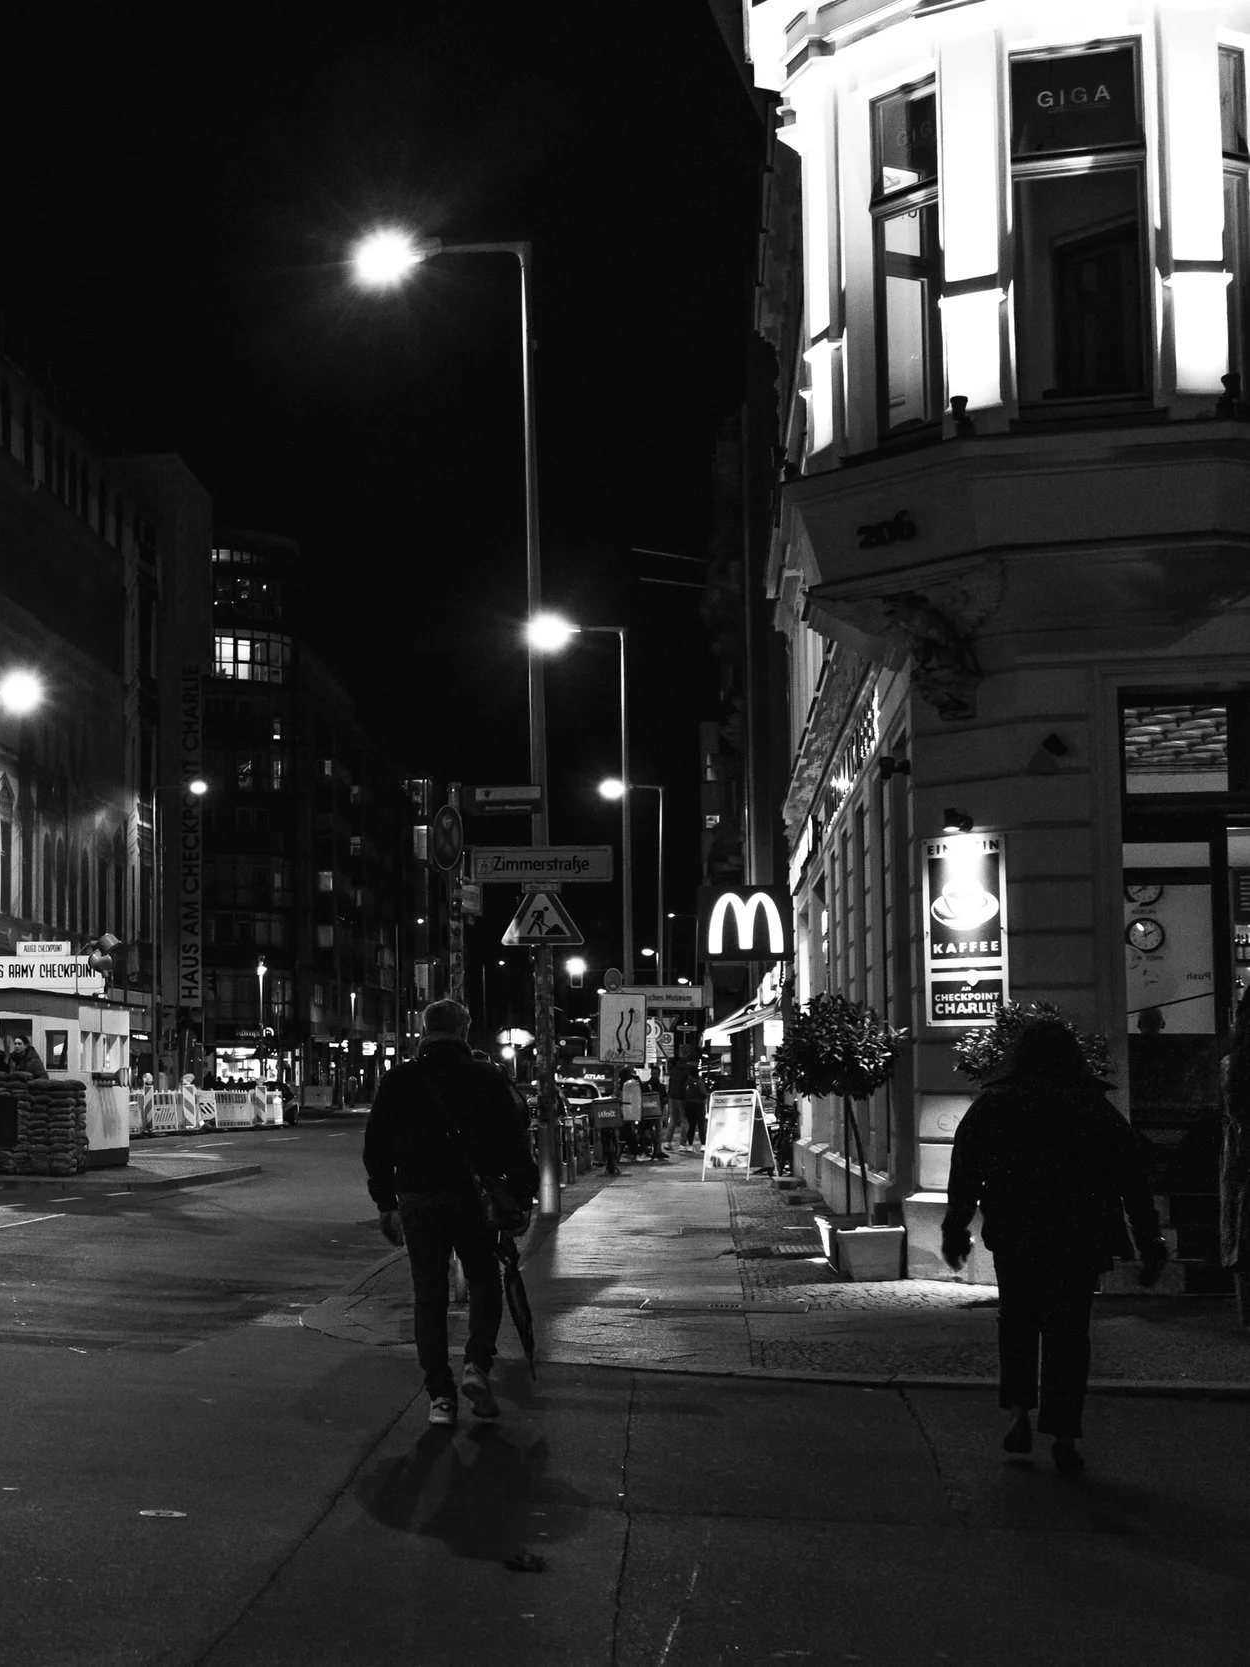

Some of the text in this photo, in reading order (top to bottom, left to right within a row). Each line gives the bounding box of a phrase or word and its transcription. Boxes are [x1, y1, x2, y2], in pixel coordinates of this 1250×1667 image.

[1037, 84, 1111, 107] GIGA
[180, 664, 200, 999] HAUS AM CHECKPONT CHARLIE
[493, 855, 590, 873] Zimmerstraße
[933, 941, 999, 954] KAFFEE
[8, 964, 35, 979] ARMY
[935, 992, 1000, 1002] CHECKPOINT
